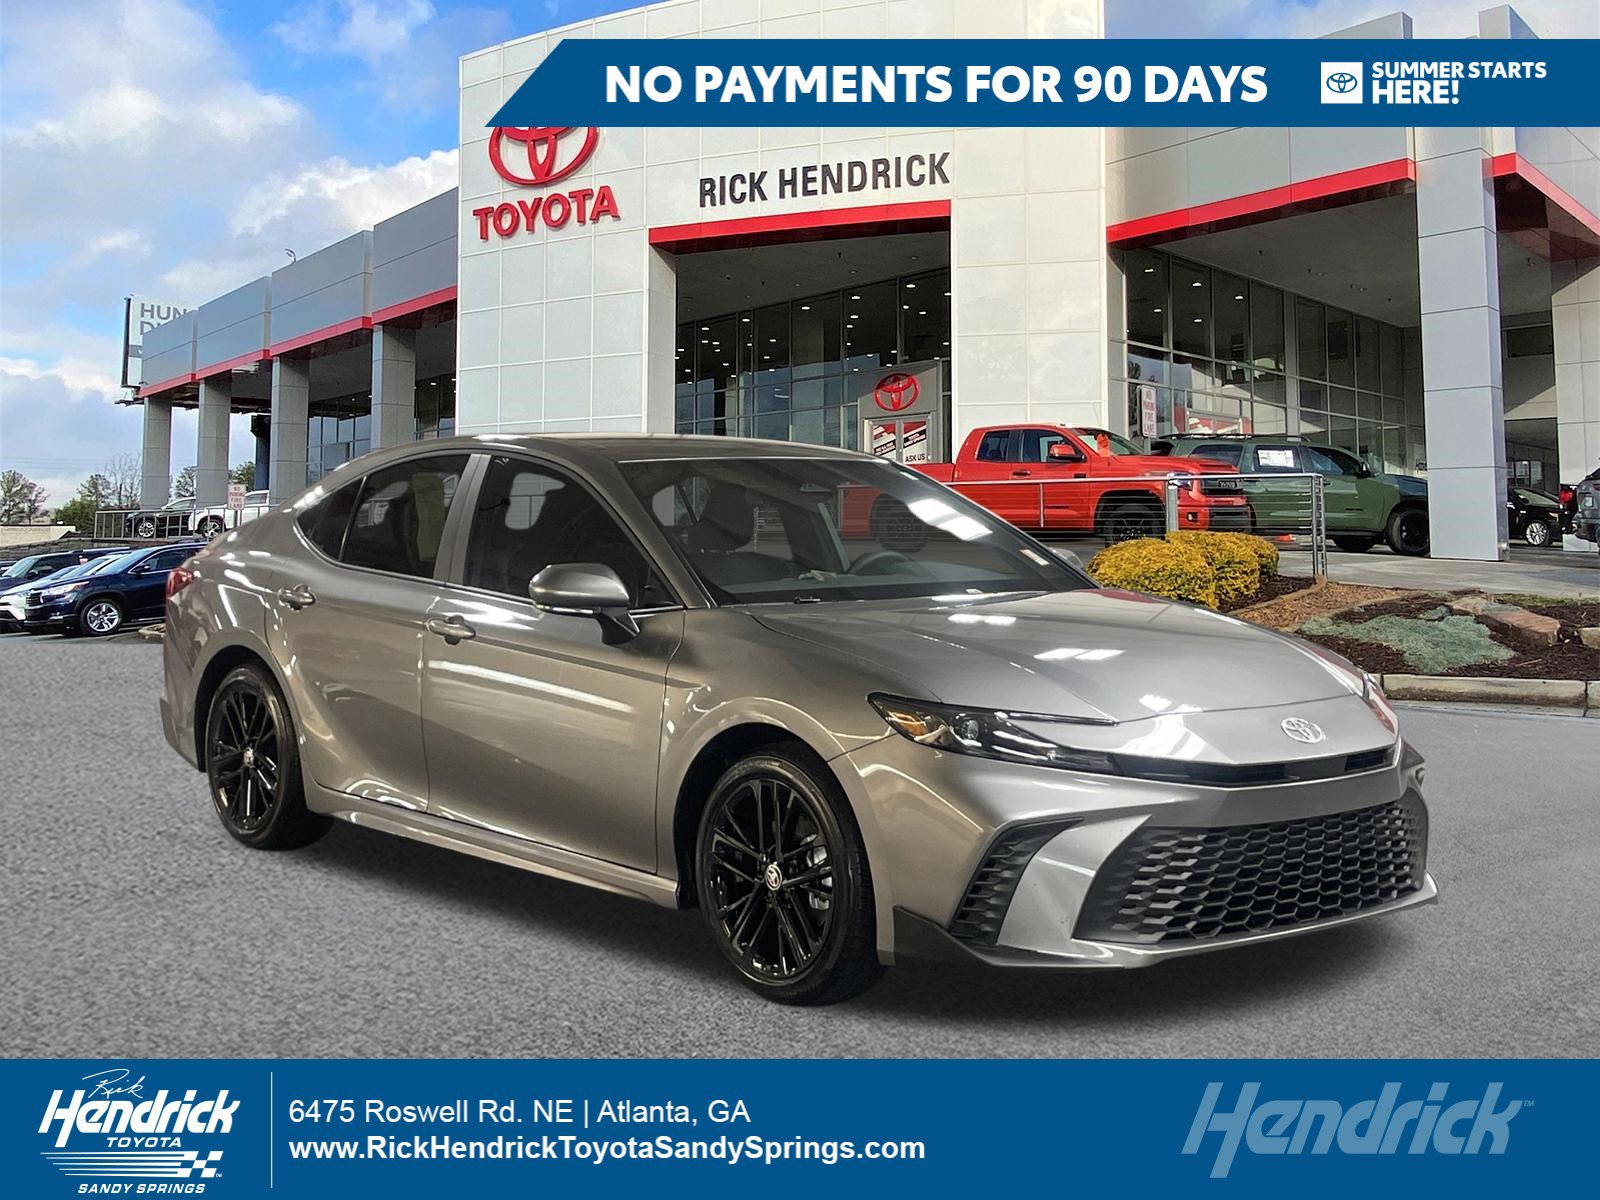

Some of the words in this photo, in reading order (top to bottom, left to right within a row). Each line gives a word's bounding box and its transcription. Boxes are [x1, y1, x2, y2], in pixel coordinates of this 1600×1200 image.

[699, 169, 769, 208] RICK
[778, 152, 951, 199] HENDRICK
[473, 185, 621, 241] TOYOTA
[905, 455, 917, 463] ASK
